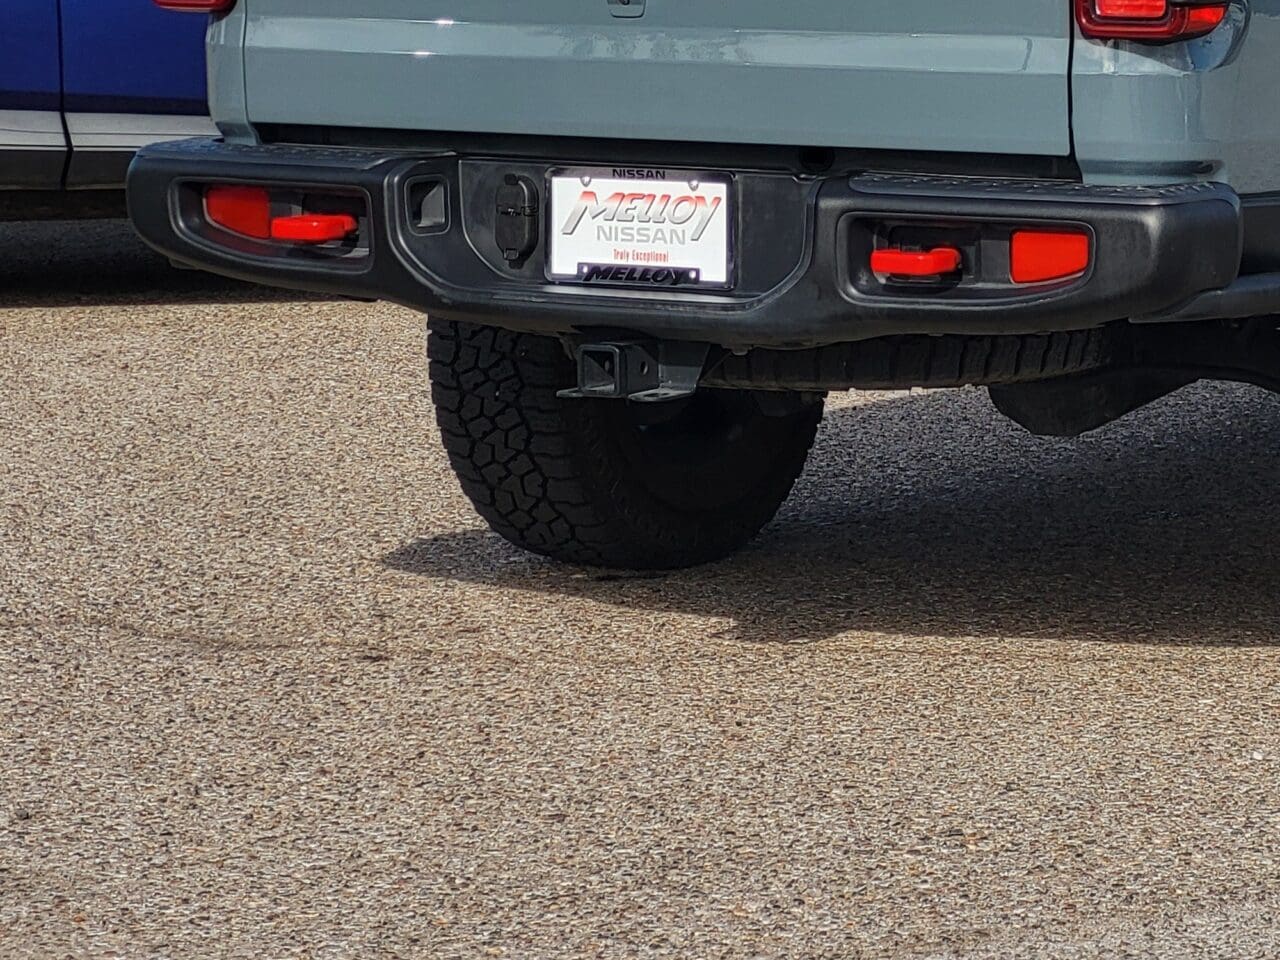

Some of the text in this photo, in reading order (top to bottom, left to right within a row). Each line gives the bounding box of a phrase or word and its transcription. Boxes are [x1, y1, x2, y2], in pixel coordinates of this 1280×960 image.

[612, 168, 666, 180] NISSAN
[596, 224, 687, 245] NISSAN
[613, 249, 669, 263] Truly Exceptional
[582, 265, 687, 285] MELLOY
